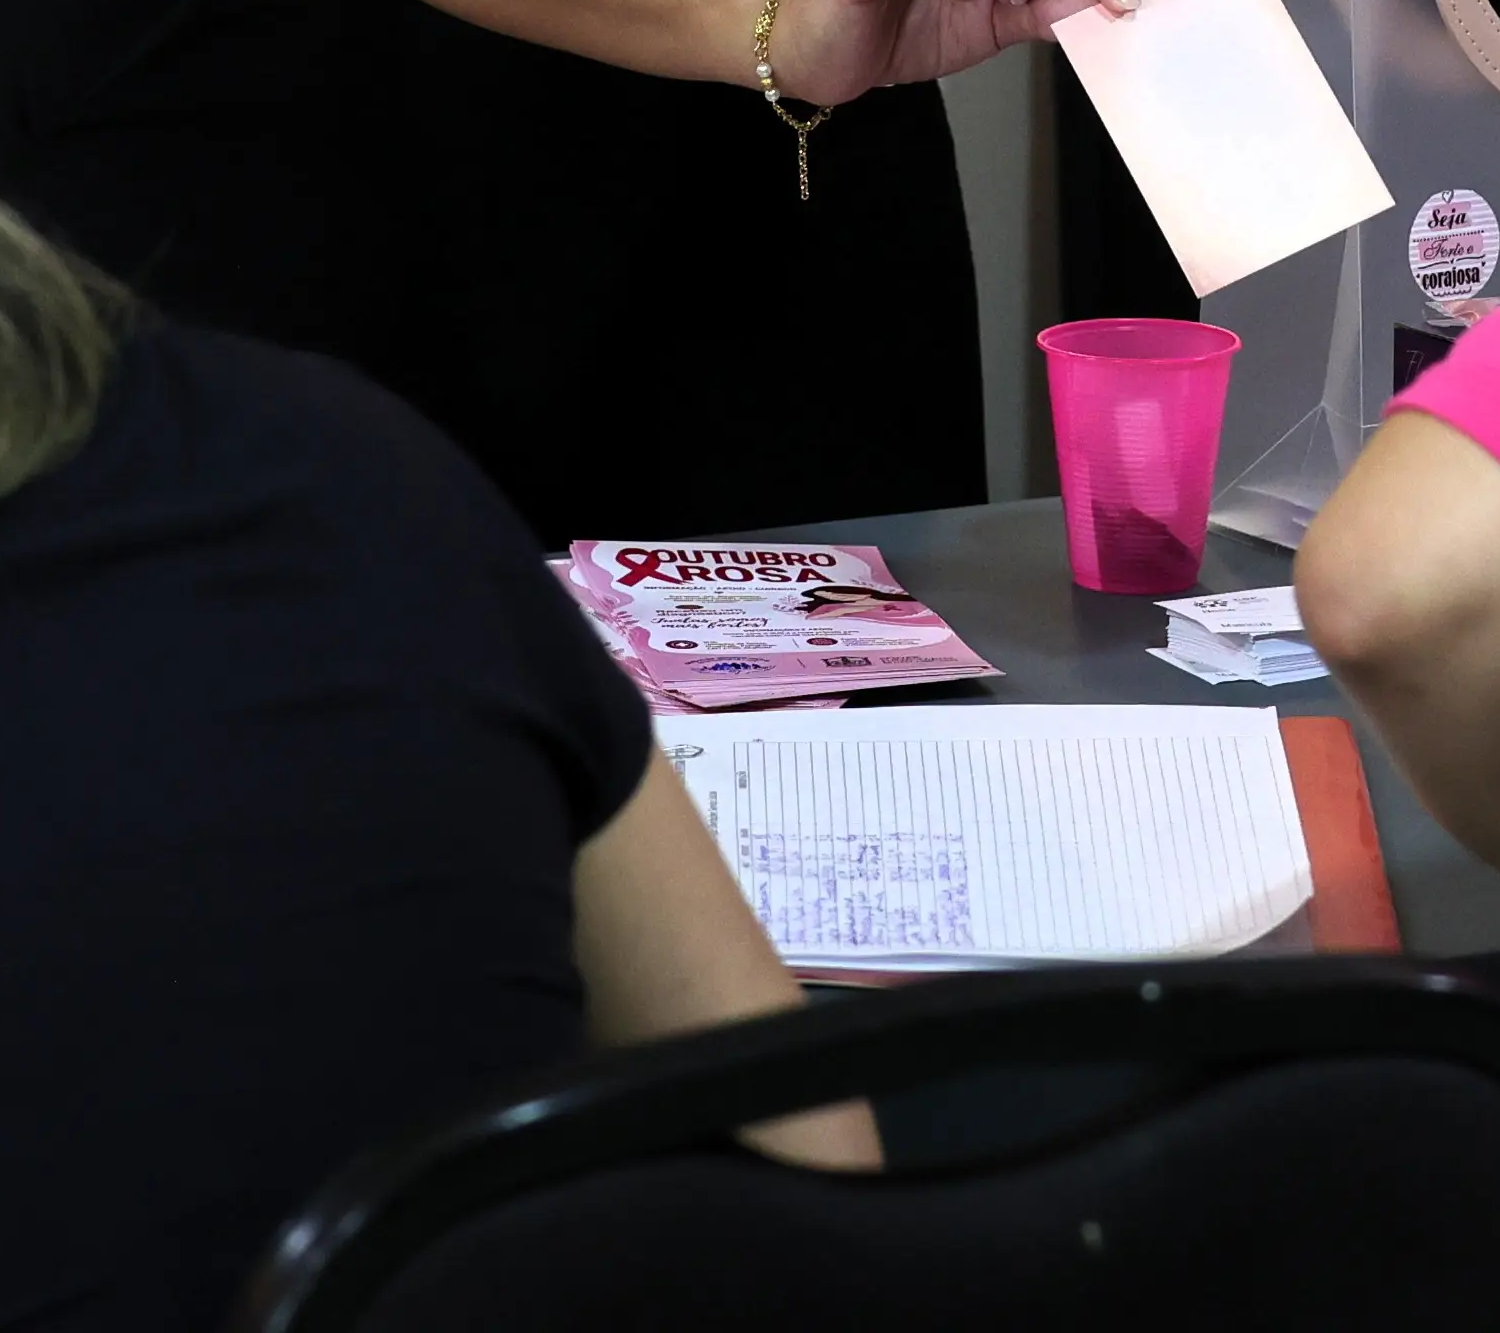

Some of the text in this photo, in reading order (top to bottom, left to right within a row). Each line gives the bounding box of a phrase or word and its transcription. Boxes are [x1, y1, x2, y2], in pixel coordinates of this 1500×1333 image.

[1427, 208, 1468, 230] Seja
[1423, 238, 1475, 260] Forte e
[1421, 265, 1481, 291] corajosa
[656, 549, 838, 568] OUTUBRO
[674, 565, 837, 584] ROSA
